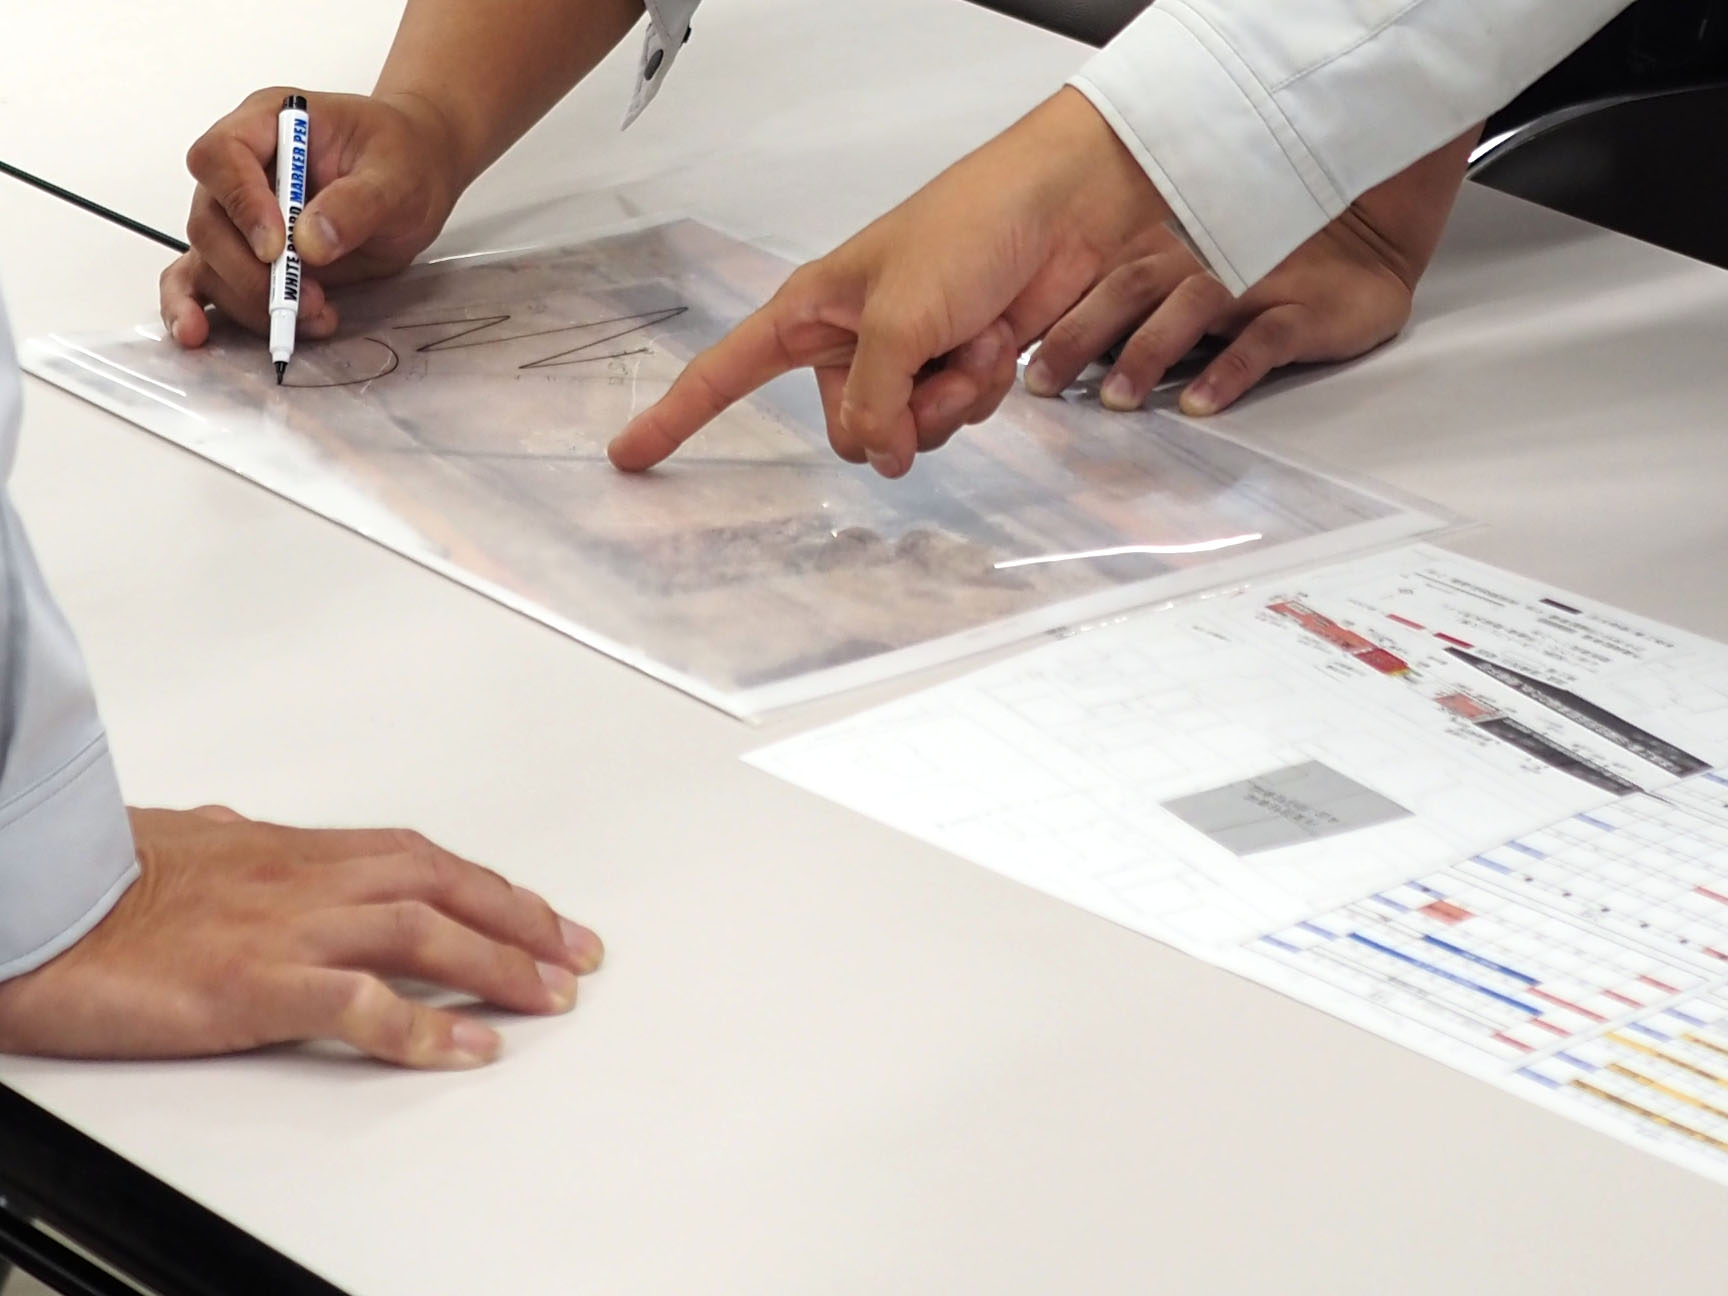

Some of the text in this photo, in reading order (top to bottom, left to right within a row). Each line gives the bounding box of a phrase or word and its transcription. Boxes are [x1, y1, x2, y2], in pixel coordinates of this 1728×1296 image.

[292, 118, 308, 145] PEN
[289, 146, 306, 204] MARKER
[283, 256, 300, 302] WHITE
